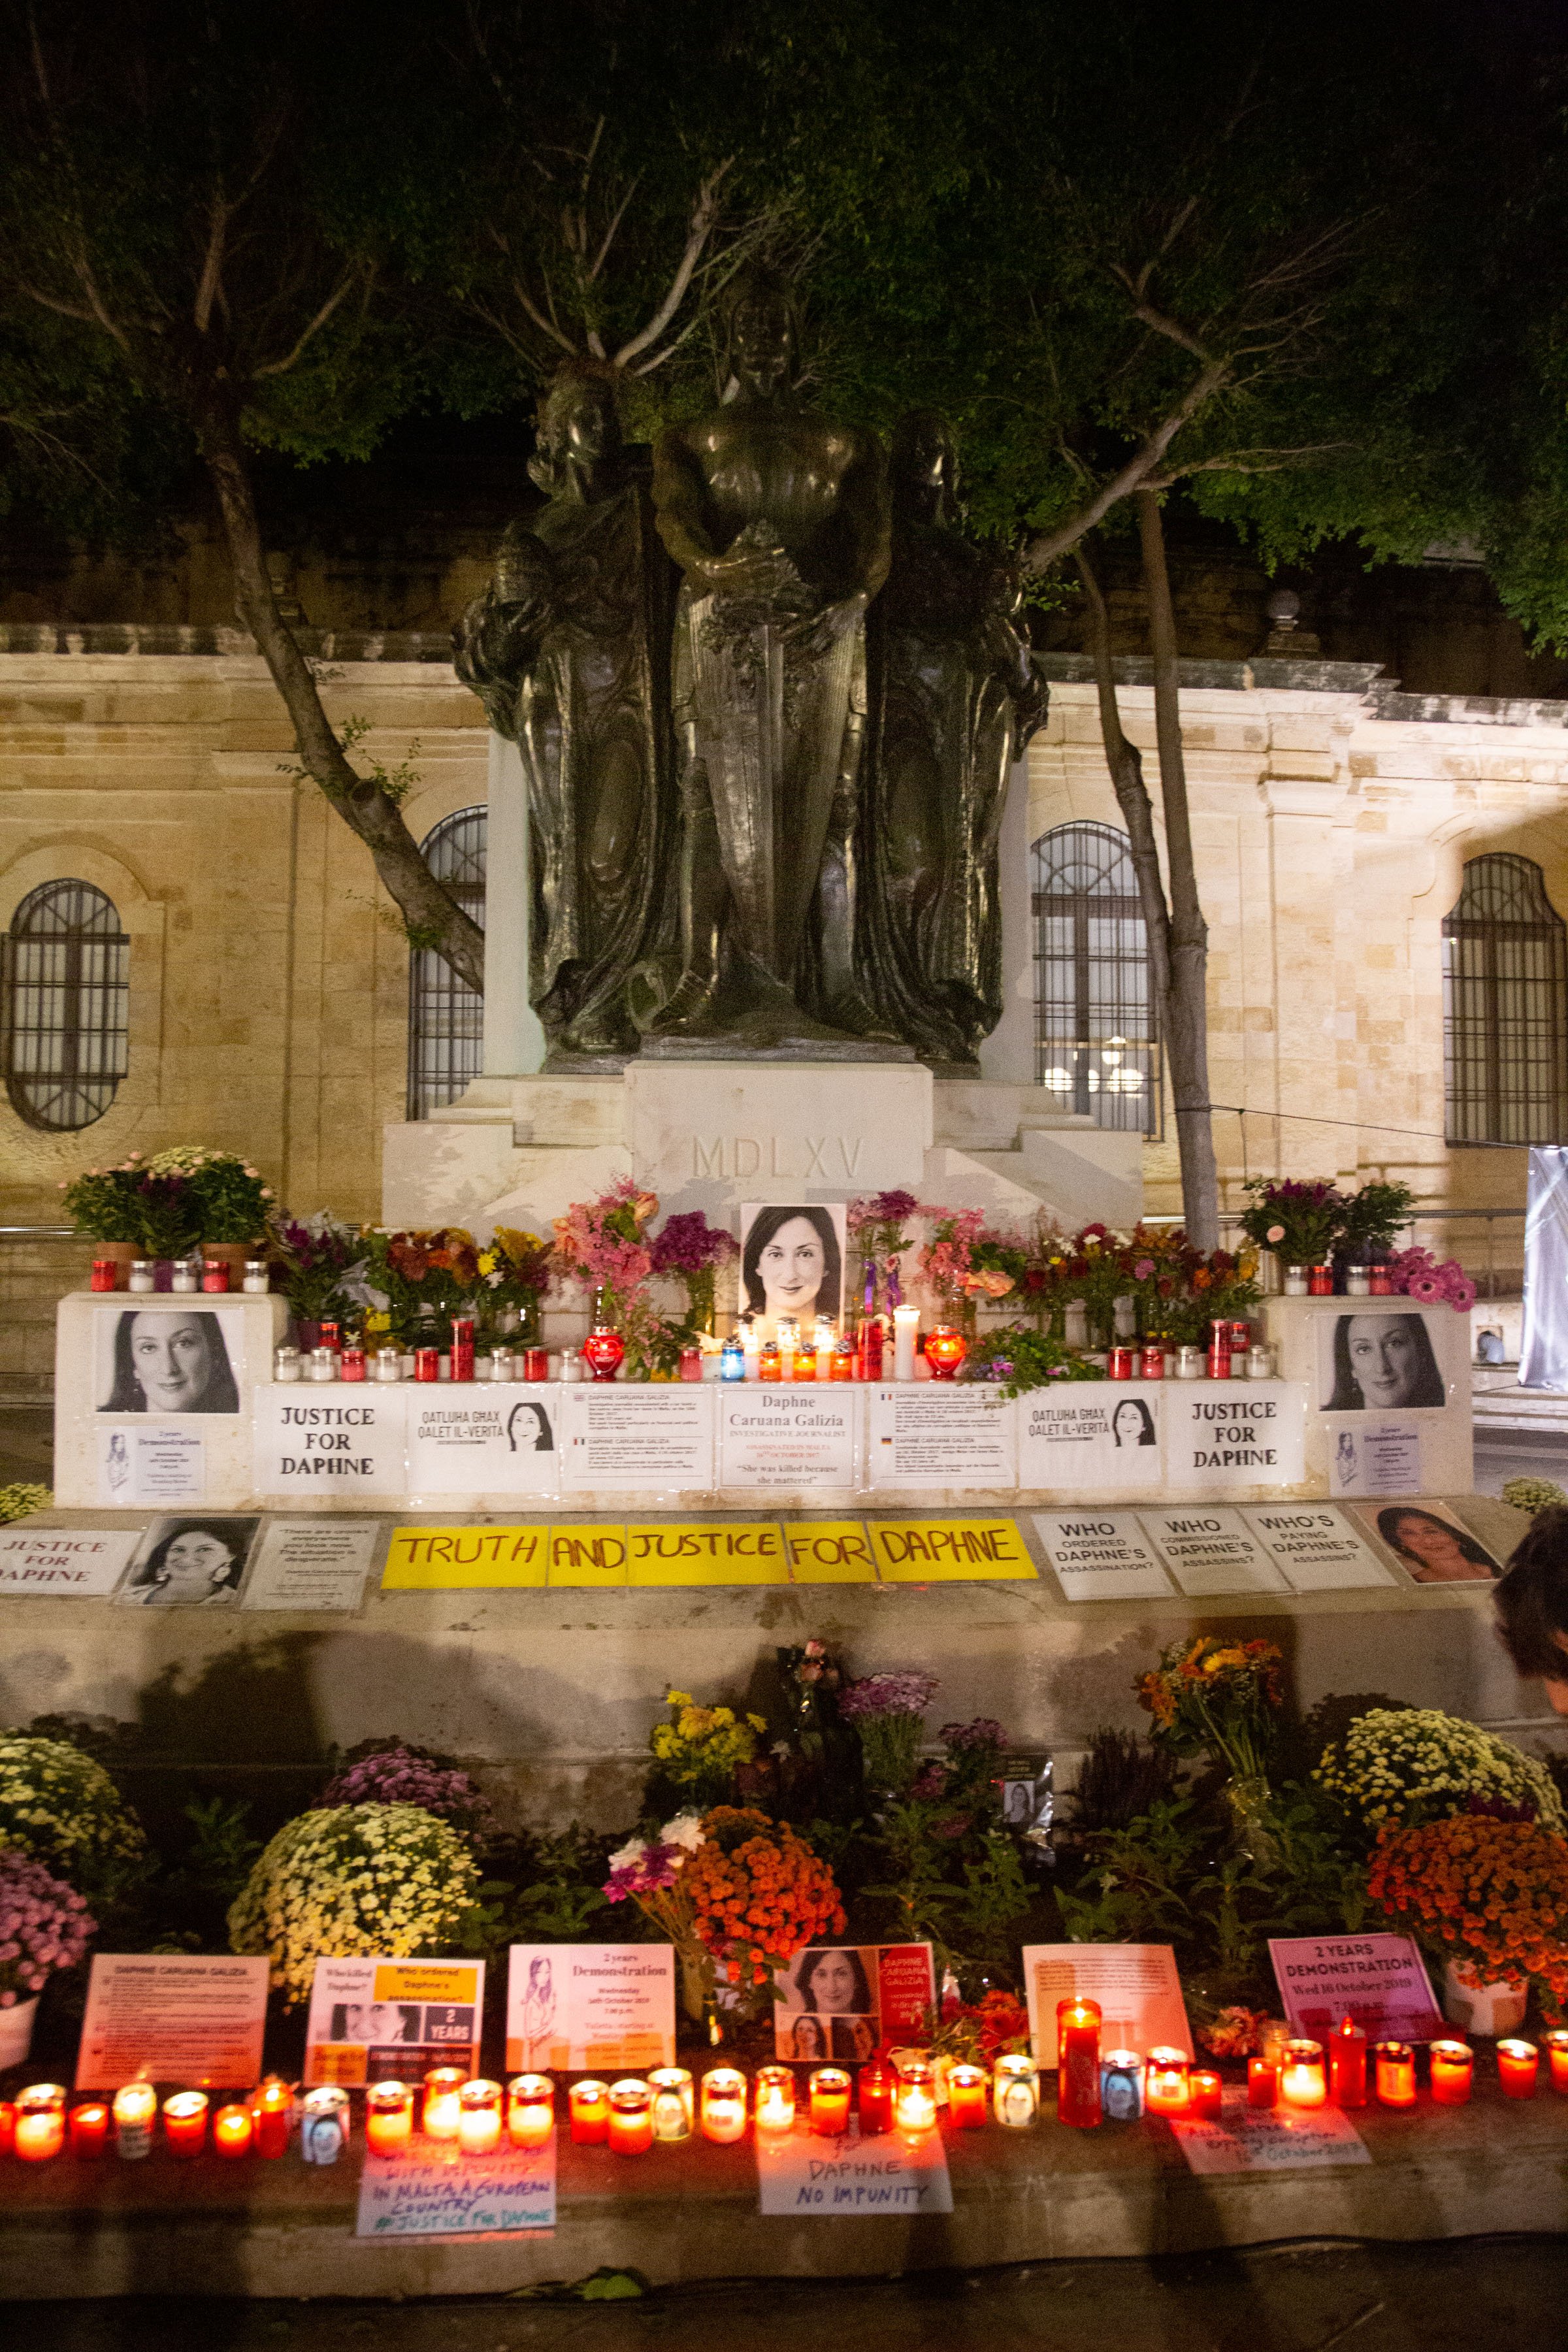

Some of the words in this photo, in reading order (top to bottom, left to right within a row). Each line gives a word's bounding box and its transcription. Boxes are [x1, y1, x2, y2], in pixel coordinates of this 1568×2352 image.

[762, 1396, 816, 1411] Daphne
[281, 1407, 375, 1426] JUSTICE
[1192, 1402, 1277, 1420] JUSTICE
[730, 1414, 791, 1426] Caruana
[795, 1414, 843, 1426] Galizia
[418, 1426, 451, 1438] QALET
[1028, 1424, 1060, 1437] QALET
[1213, 1427, 1256, 1443] FOR
[304, 1433, 351, 1450] FOR
[1193, 1449, 1277, 1467] DAPHNE
[280, 1458, 374, 1475] DAPHNE
[1165, 1519, 1221, 1533] WHO
[1258, 1515, 1334, 1529] WHO'S
[1058, 1522, 1115, 1537] WHO
[1062, 1539, 1127, 1548] ORDERED
[1160, 1534, 1240, 1543] COMMISSIONED
[3, 1541, 108, 1552] JUSTICE
[398, 1535, 539, 1563] TRUTH
[553, 1537, 625, 1569] AND
[632, 1533, 777, 1558] JUSTICE
[789, 1536, 876, 1565] FOR
[879, 1529, 1019, 1564] DAPHNE
[1166, 1542, 1254, 1556] DAPHNE'S
[1272, 1541, 1360, 1553] DAPHNE'S
[25, 1556, 70, 1565] FOR
[1055, 1549, 1147, 1562] DAPHNE'S
[1182, 1556, 1255, 1567] ASSASSINS?
[1292, 1553, 1357, 1564] ASSASSINS?
[1060, 1561, 1154, 1573] ASSASSINATION?
[0, 1569, 91, 1582] APHNE
[1315, 1946, 1324, 1957] 2
[1327, 1944, 1373, 1957] YEARS
[604, 1953, 610, 1962] 2
[612, 1954, 638, 1963] years
[573, 1965, 667, 1976] Demonstration
[1286, 1958, 1413, 1976] DEMONSTRATION
[1292, 1983, 1319, 1995] Wed
[1336, 1981, 1382, 1992] October
[446, 2009, 456, 2023] 2
[431, 2025, 470, 2040] YEARS
[809, 2159, 902, 2181] DAPHNE
[462, 2180, 472, 2195] A
[796, 2187, 824, 2205] NO
[833, 2185, 929, 2204] IMPUNITY
[391, 2198, 478, 2215] COUNTRY
